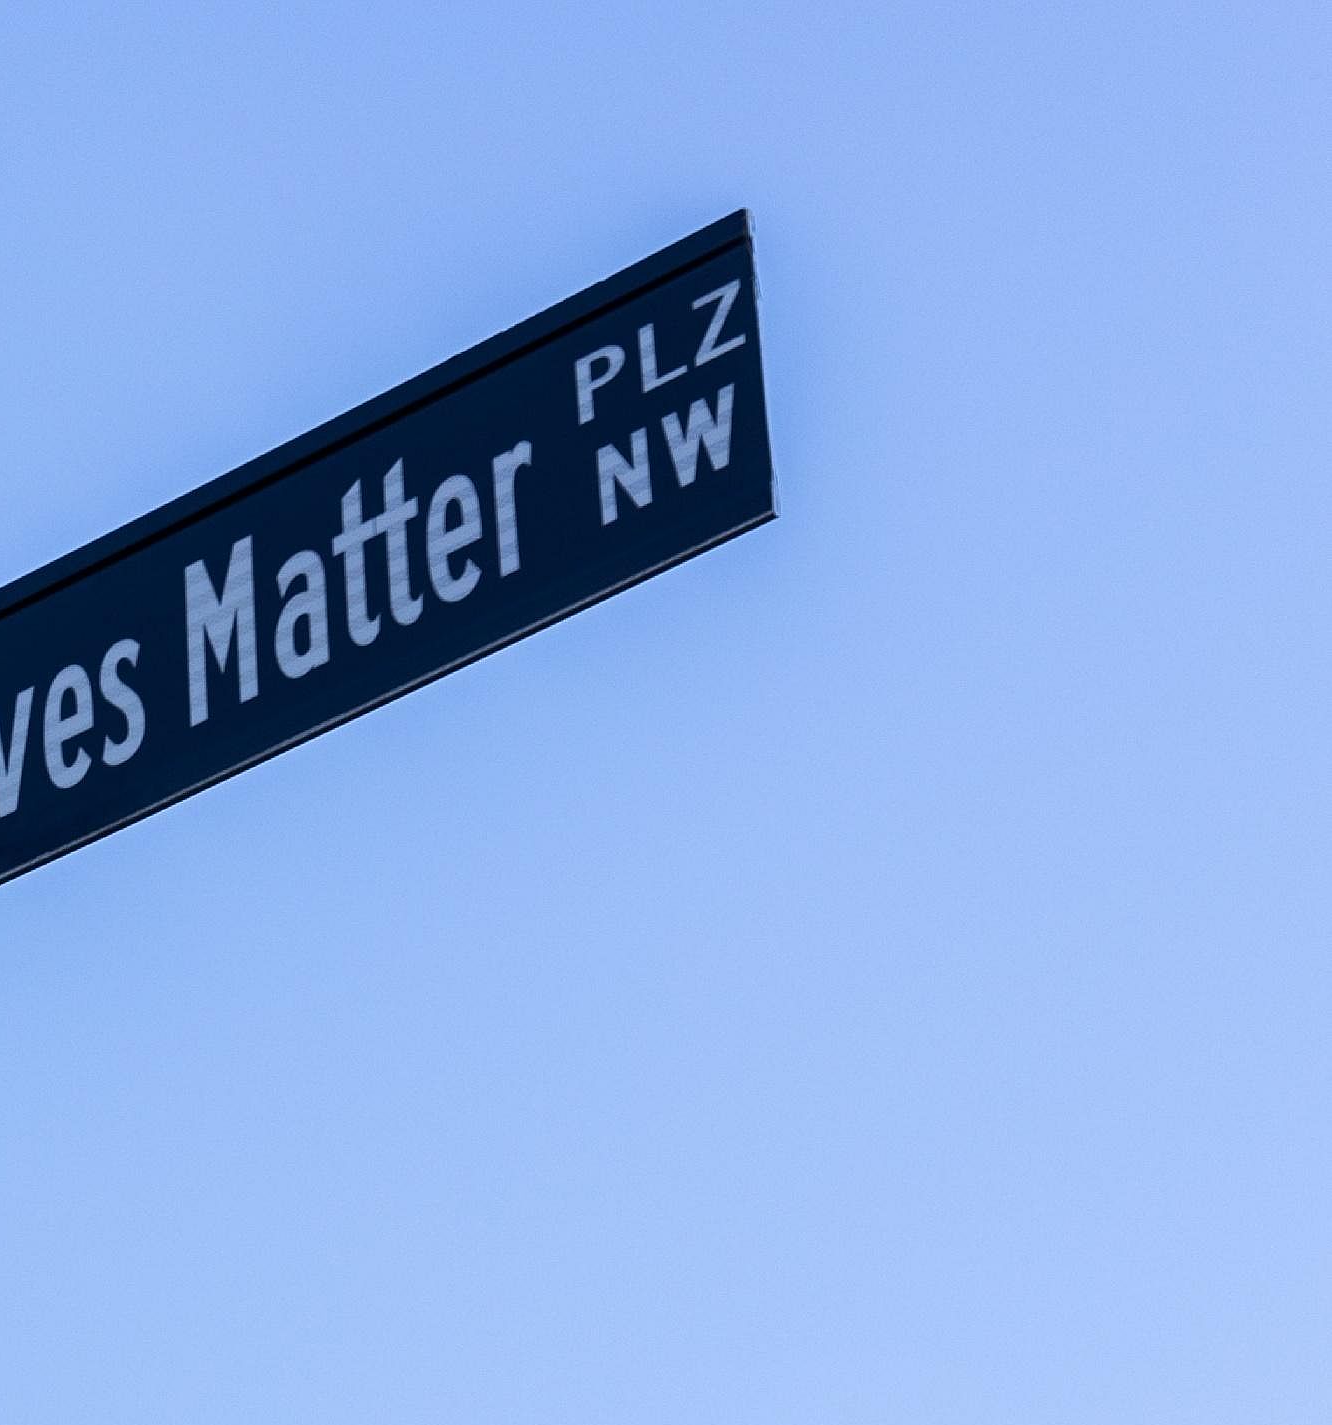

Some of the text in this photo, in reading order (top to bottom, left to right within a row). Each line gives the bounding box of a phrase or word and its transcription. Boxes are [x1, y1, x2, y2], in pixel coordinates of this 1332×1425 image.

[575, 278, 747, 425] PLZ
[596, 382, 735, 527] NW
[184, 439, 533, 728] Matter
